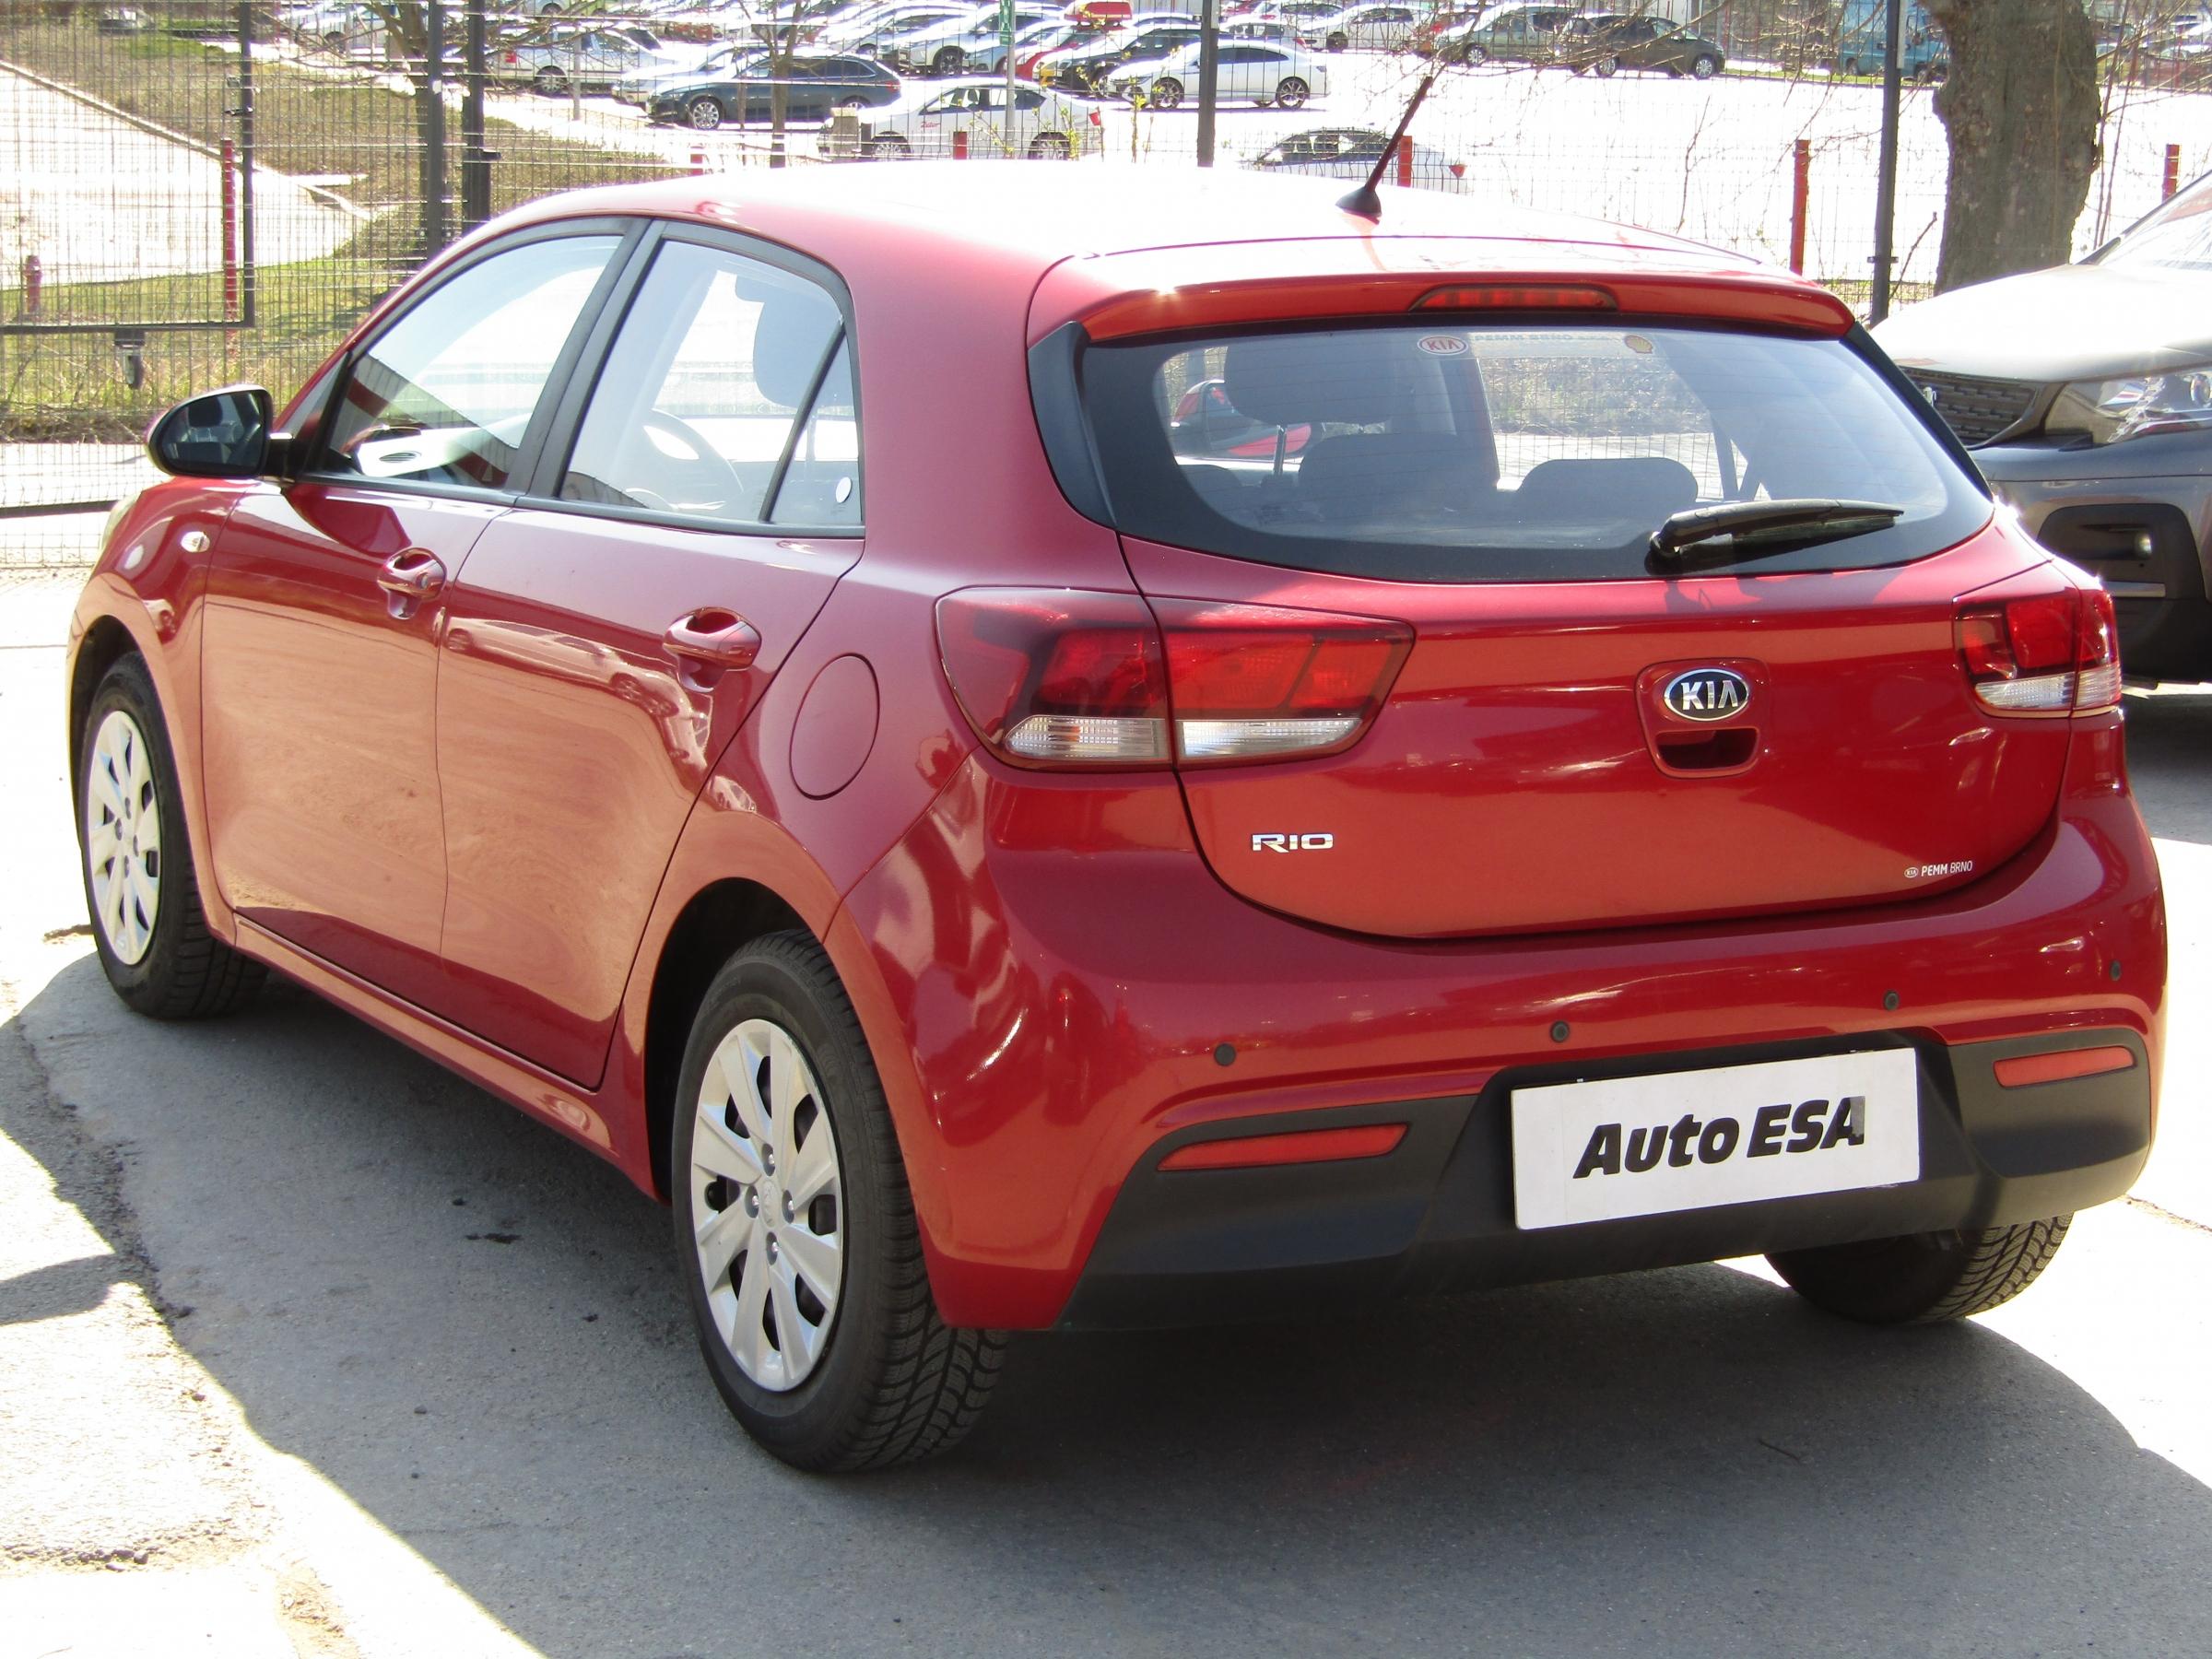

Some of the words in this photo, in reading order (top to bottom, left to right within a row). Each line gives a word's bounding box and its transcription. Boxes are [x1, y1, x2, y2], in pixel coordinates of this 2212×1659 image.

[1680, 679, 1739, 711] KIA
[1252, 833, 1334, 853] RIO
[1921, 863, 1948, 877] PEMM
[1949, 860, 1973, 874] BRNO
[1572, 1113, 1740, 1179] Auto
[1747, 1095, 1866, 1159] ESA
